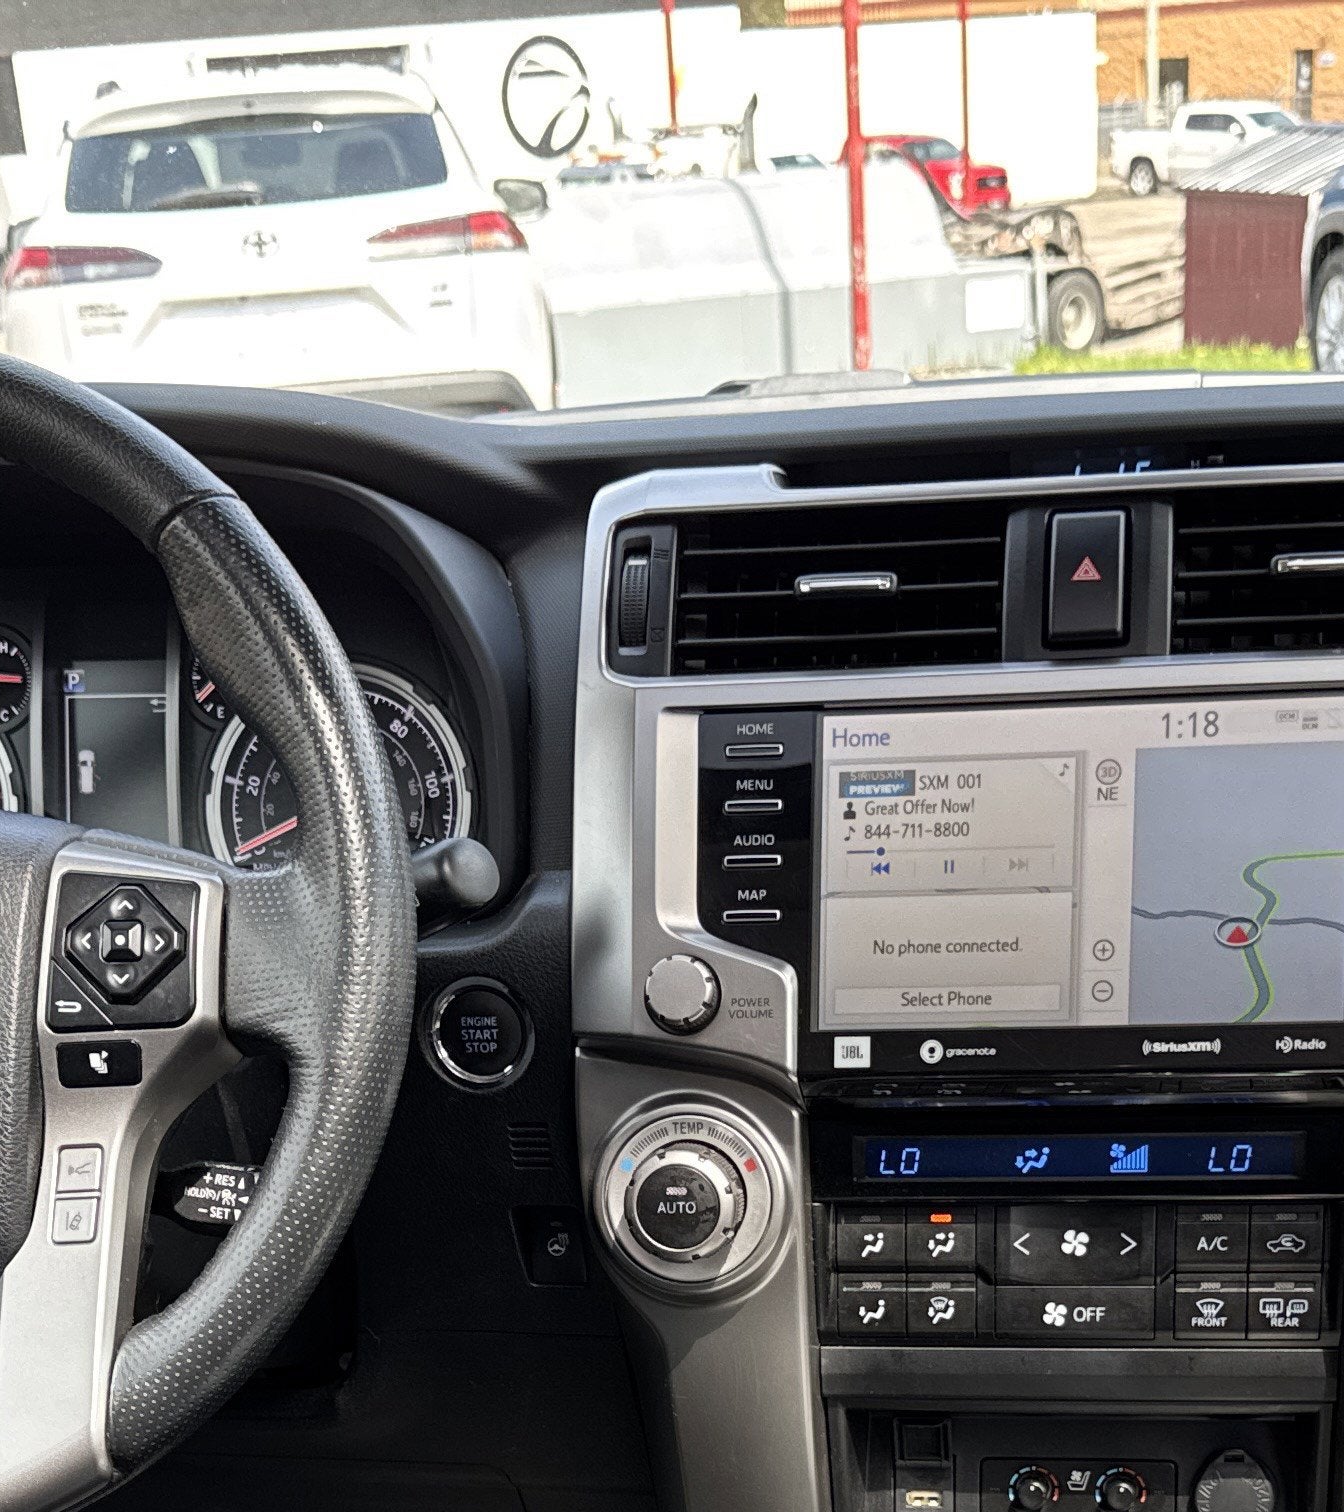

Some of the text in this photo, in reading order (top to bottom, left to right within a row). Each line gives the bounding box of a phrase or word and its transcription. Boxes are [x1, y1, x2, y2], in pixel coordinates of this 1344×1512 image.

[68, 673, 80, 690] P
[0, 709, 10, 722] C
[390, 719, 408, 738] 80
[737, 723, 774, 736] HOME
[1161, 710, 1219, 739] 1:18
[832, 728, 891, 748] Home
[246, 775, 260, 797] 20
[425, 770, 440, 799] 100
[736, 779, 774, 791] MENU
[918, 773, 982, 791] SXM 001
[849, 784, 906, 798] PREVIEW
[1097, 786, 1119, 801] NE
[864, 797, 975, 816] Great Offer Now!
[864, 821, 970, 839] 844-711-8800
[734, 834, 774, 846] AUDIO
[738, 889, 767, 901] MAP
[873, 937, 1023, 957] No phone connected.
[730, 998, 770, 1008] POWER
[901, 991, 992, 1007] Select Phone
[461, 1016, 497, 1027] ENGINE
[729, 1009, 774, 1019] VOLUME
[461, 1029, 499, 1040] START
[465, 1042, 498, 1053] STOP
[1294, 1038, 1327, 1050] Radio
[842, 1045, 864, 1059] JBL
[672, 1121, 704, 1136] TEMP
[880, 1147, 921, 1175] LO
[1208, 1144, 1252, 1172] LO
[657, 1201, 697, 1215] AUTO
[1196, 1236, 1229, 1252] A/C
[1073, 1307, 1106, 1322] OFF
[1191, 1317, 1227, 1327] FRONT
[1271, 1317, 1299, 1327] REAR
